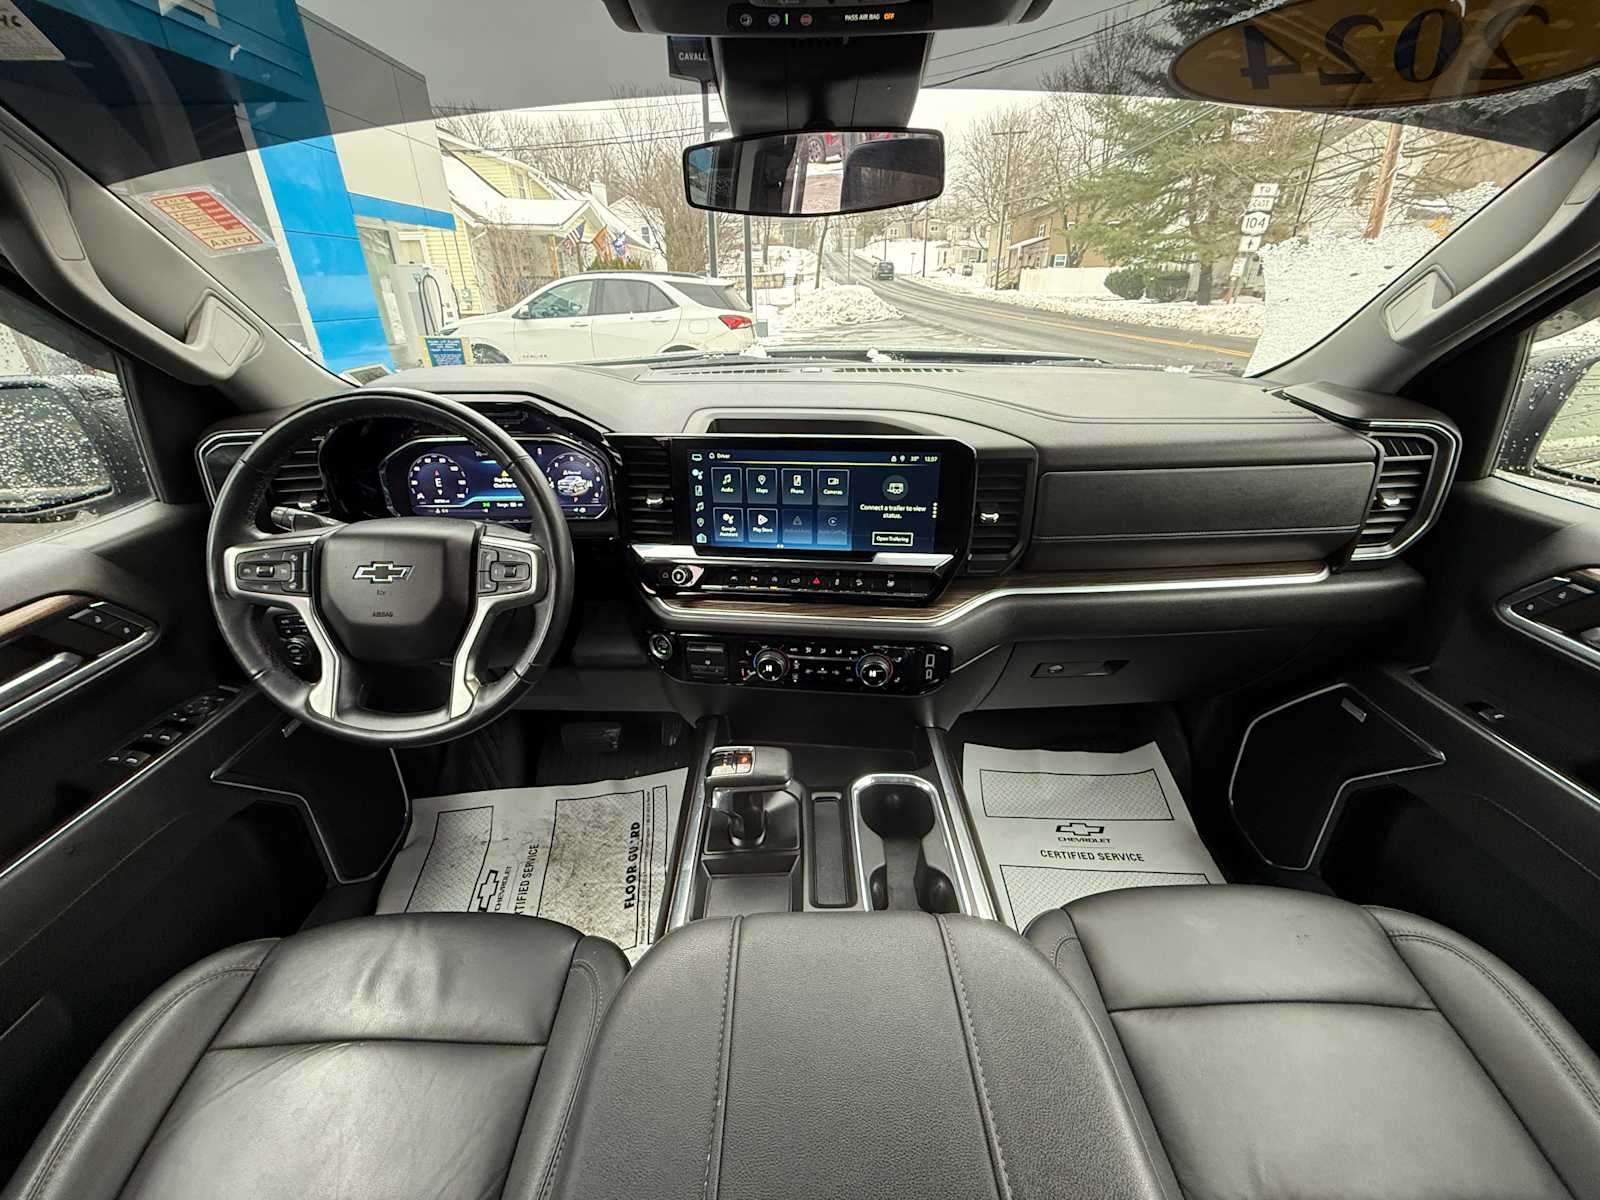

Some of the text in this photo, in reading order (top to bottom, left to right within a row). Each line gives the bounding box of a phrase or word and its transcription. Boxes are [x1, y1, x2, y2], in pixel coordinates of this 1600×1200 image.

[844, 12, 895, 21] PASS AIR BAG OFF
[1245, 217, 1266, 229] 104
[435, 477, 443, 488] E
[860, 503, 884, 511] Connect
[889, 504, 906, 512] trailer
[1057, 836, 1112, 844] CHEVROLET
[522, 843, 540, 879] SERVICE
[1040, 849, 1145, 862] CERTIFIED SERVICE
[624, 822, 641, 910] FLOOR GURD
